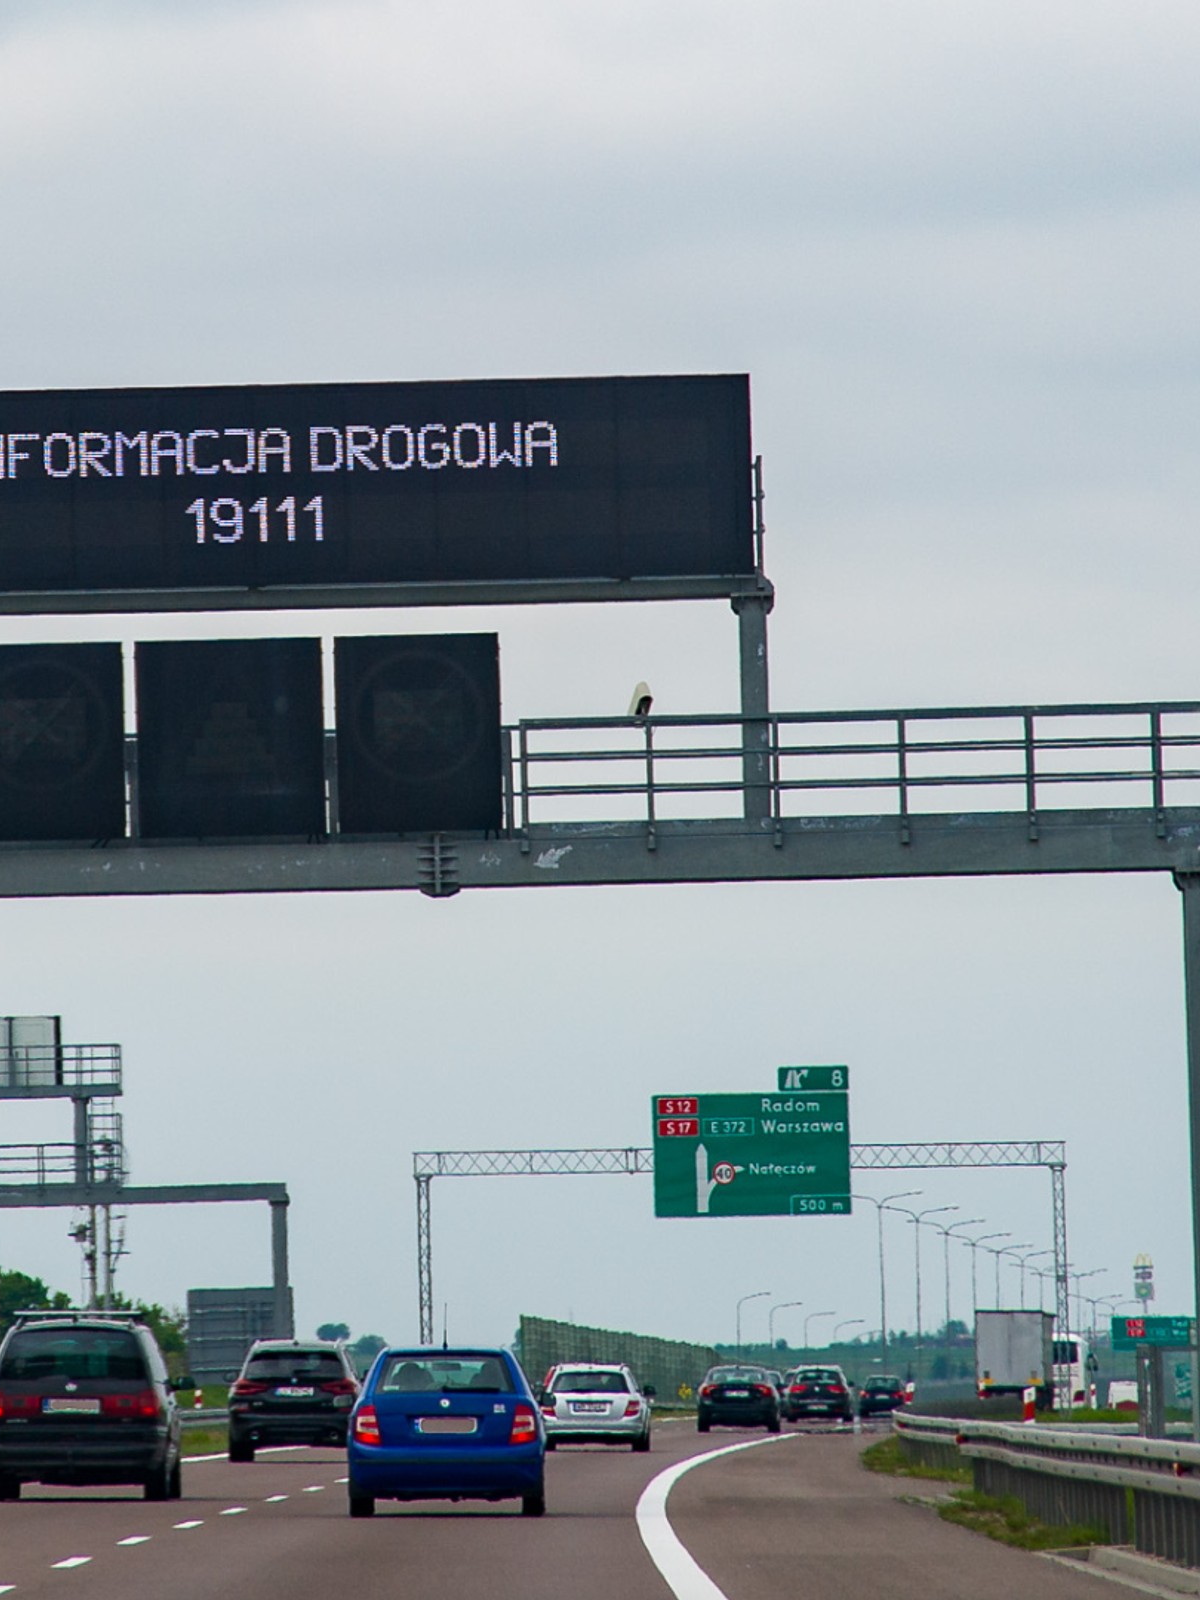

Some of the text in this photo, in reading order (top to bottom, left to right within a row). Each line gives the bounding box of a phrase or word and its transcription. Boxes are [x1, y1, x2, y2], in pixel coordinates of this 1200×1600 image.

[309, 421, 558, 473] DROGOWA
[185, 495, 325, 543] 19111
[831, 1069, 844, 1087] 8
[666, 1100, 691, 1113] S 12
[761, 1098, 820, 1113] Radom
[666, 1122, 691, 1134] S 17
[711, 1121, 746, 1133] E 372
[761, 1119, 844, 1134] Warszawa
[717, 1167, 732, 1179] 40
[749, 1163, 816, 1178] Nałęczów
[800, 1200, 826, 1211] 500
